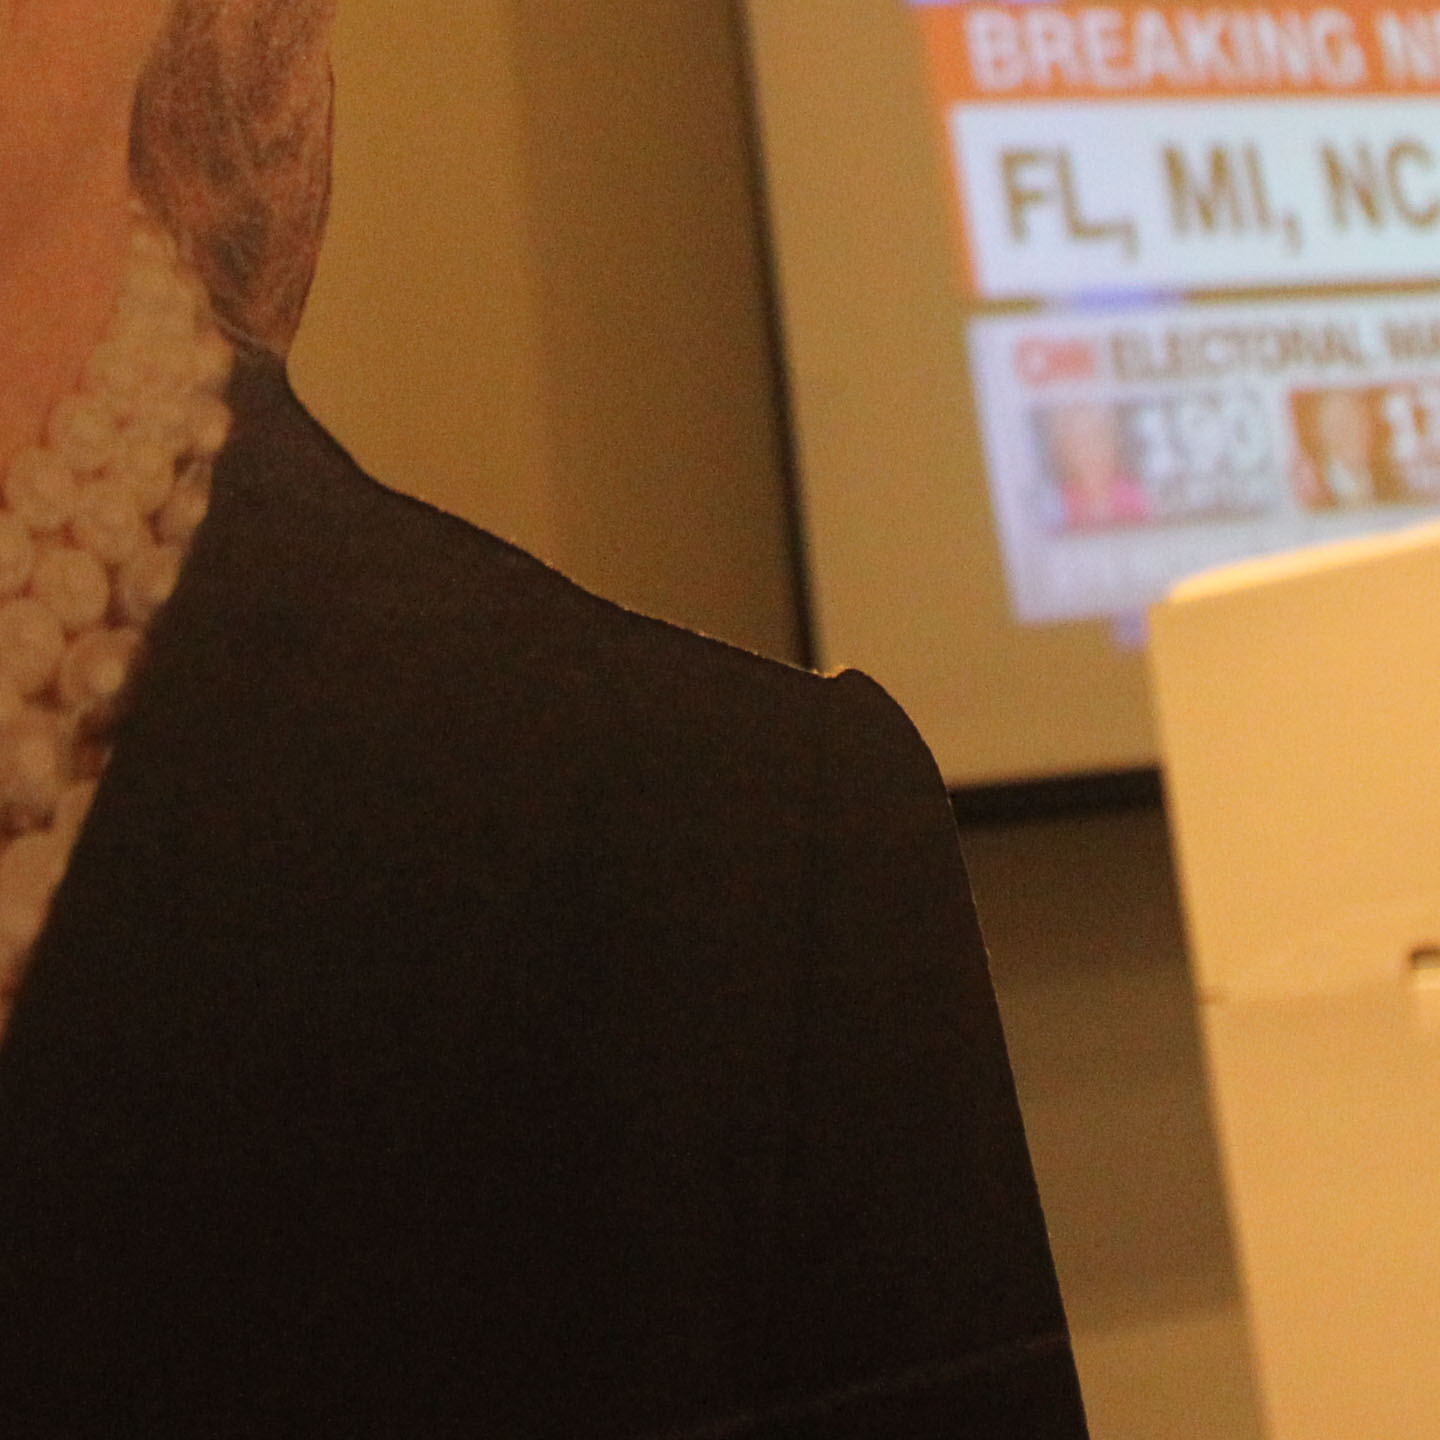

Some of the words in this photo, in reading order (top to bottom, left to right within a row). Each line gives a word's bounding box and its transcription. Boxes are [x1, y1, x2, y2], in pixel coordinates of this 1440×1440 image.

[967, 7, 1362, 91] BREAKING
[997, 145, 1140, 262] FL,
[1158, 138, 1303, 258] MI,
[1110, 317, 1368, 382] ELECTORAL
